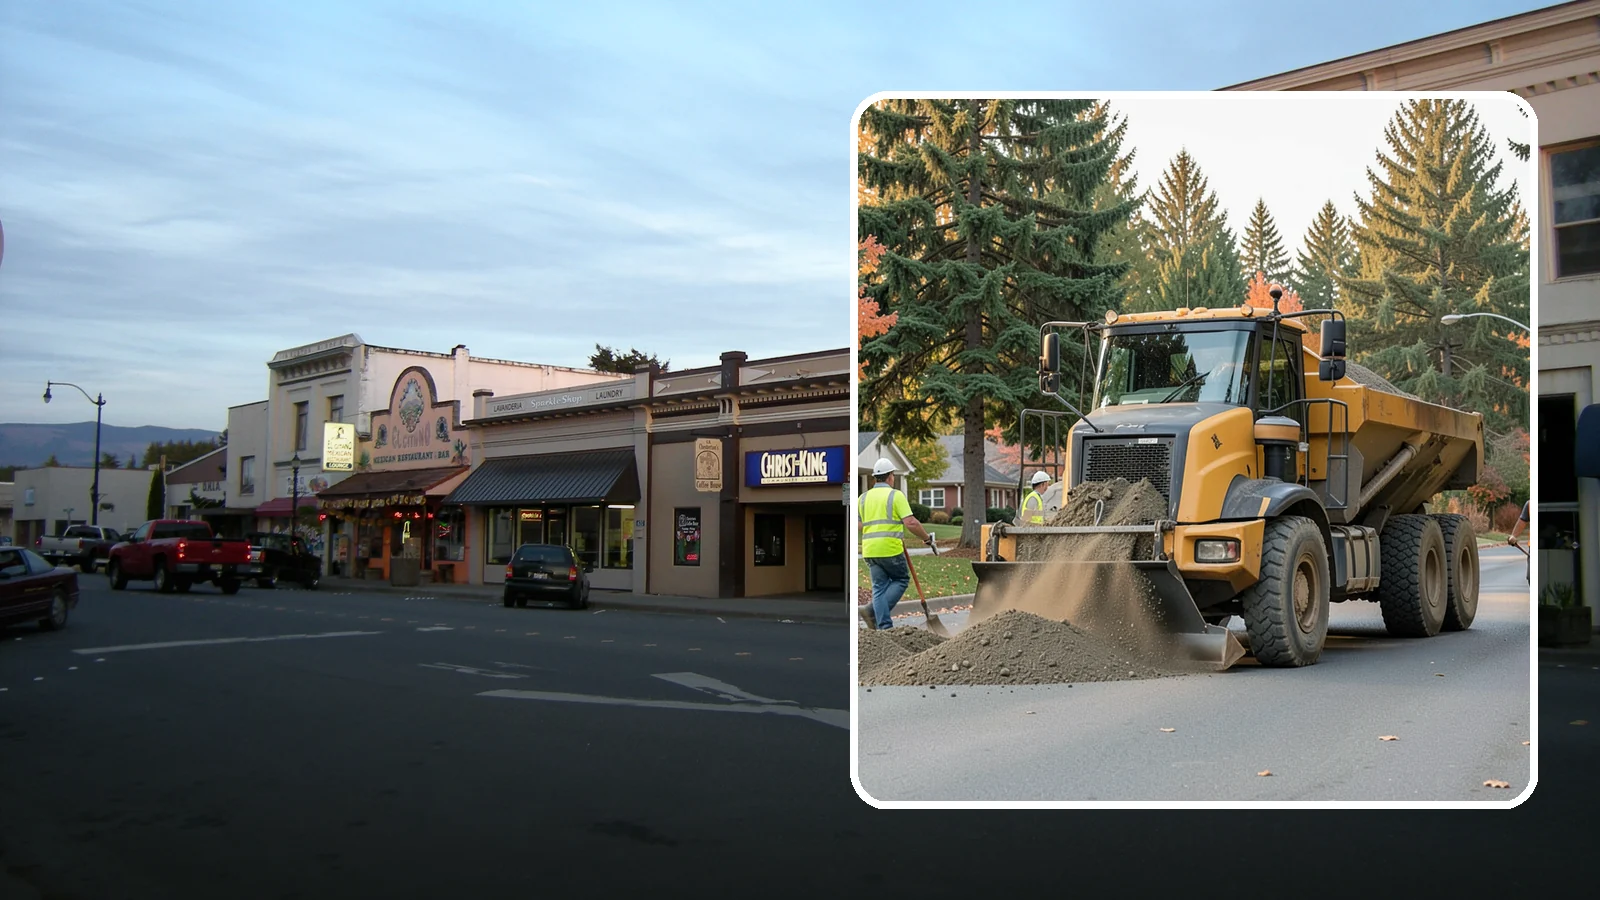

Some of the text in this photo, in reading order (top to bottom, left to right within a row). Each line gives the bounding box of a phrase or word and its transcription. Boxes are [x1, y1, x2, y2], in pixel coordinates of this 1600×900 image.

[562, 394, 582, 405] Shop
[595, 389, 624, 400] LAUNDRY
[493, 402, 523, 413] LAVANDERIA
[373, 450, 450, 464] MEXICAN RESTAURANT BAR
[760, 450, 827, 478] CHRIST KING
